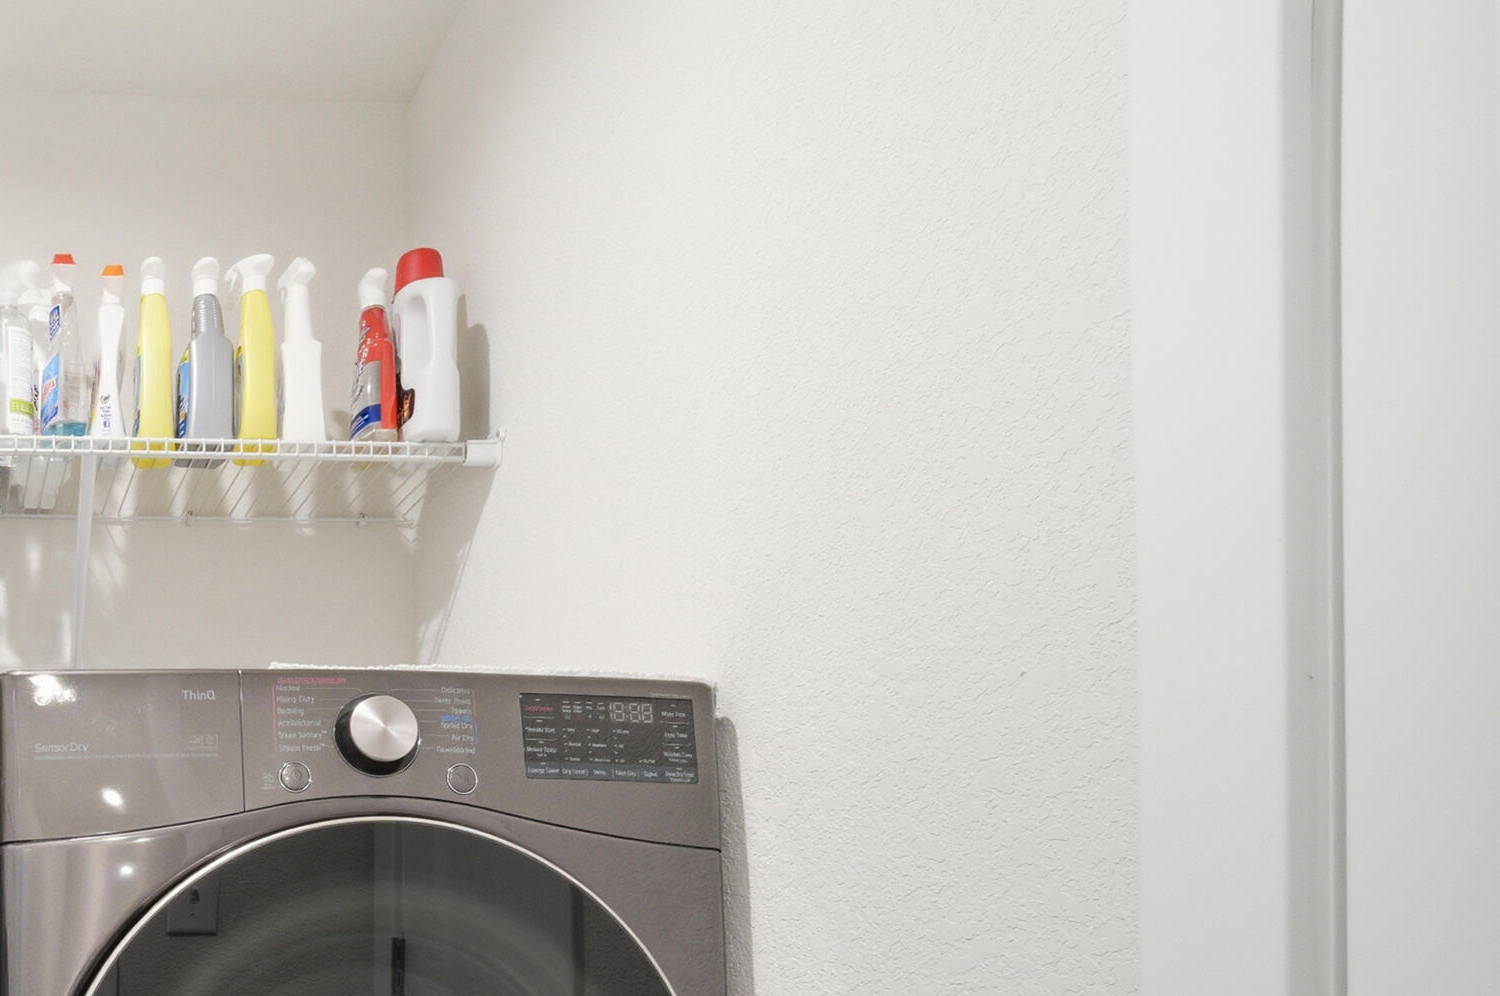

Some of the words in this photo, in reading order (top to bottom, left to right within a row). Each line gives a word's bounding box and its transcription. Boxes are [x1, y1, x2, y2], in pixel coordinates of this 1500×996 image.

[181, 689, 216, 701] ThinQ
[34, 743, 68, 753] Sensor
[69, 742, 89, 754] Dry
